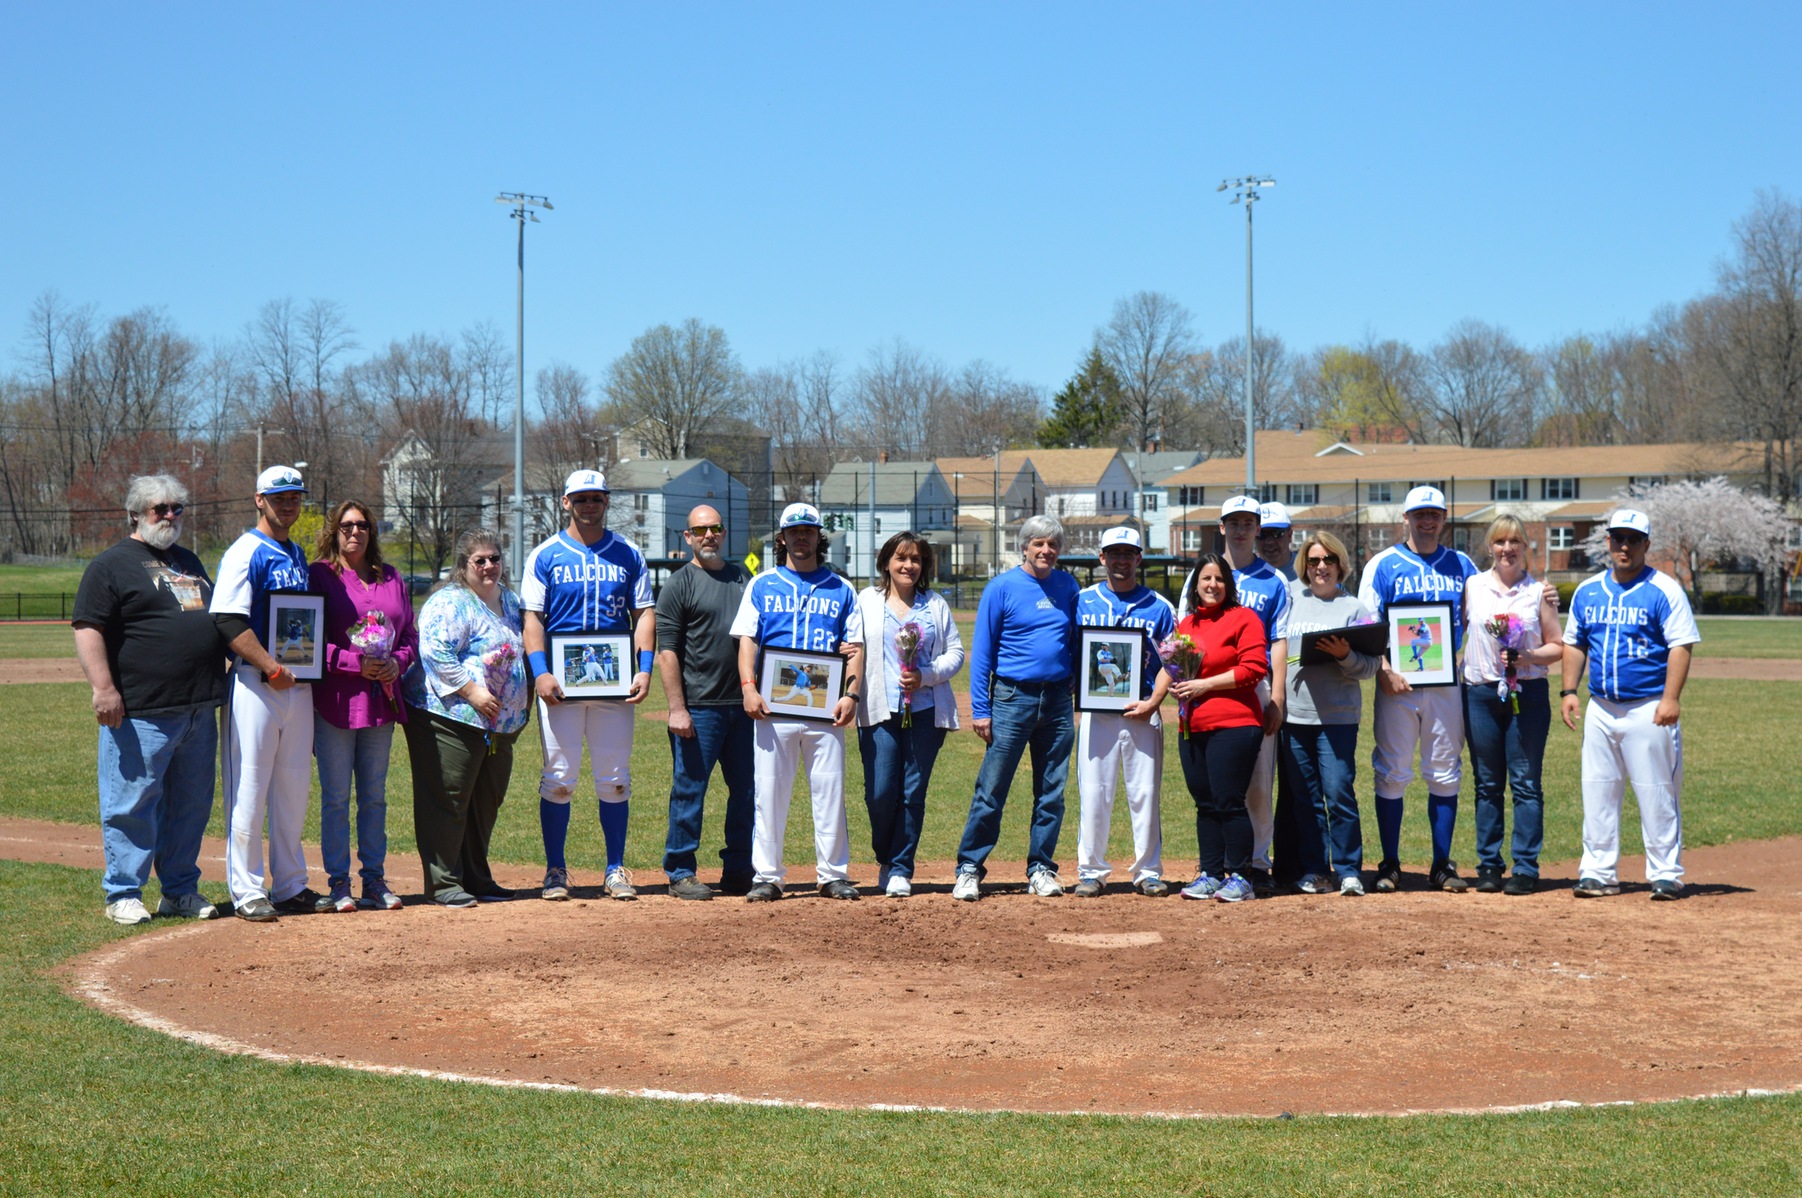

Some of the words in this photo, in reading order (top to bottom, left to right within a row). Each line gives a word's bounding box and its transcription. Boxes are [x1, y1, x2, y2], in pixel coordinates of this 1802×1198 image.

[553, 563, 628, 585] FALCONS
[1395, 574, 1463, 596] FALCONS
[763, 594, 840, 618] FALCONS
[1585, 605, 1649, 626] FALCONS
[1626, 637, 1650, 659] 12
